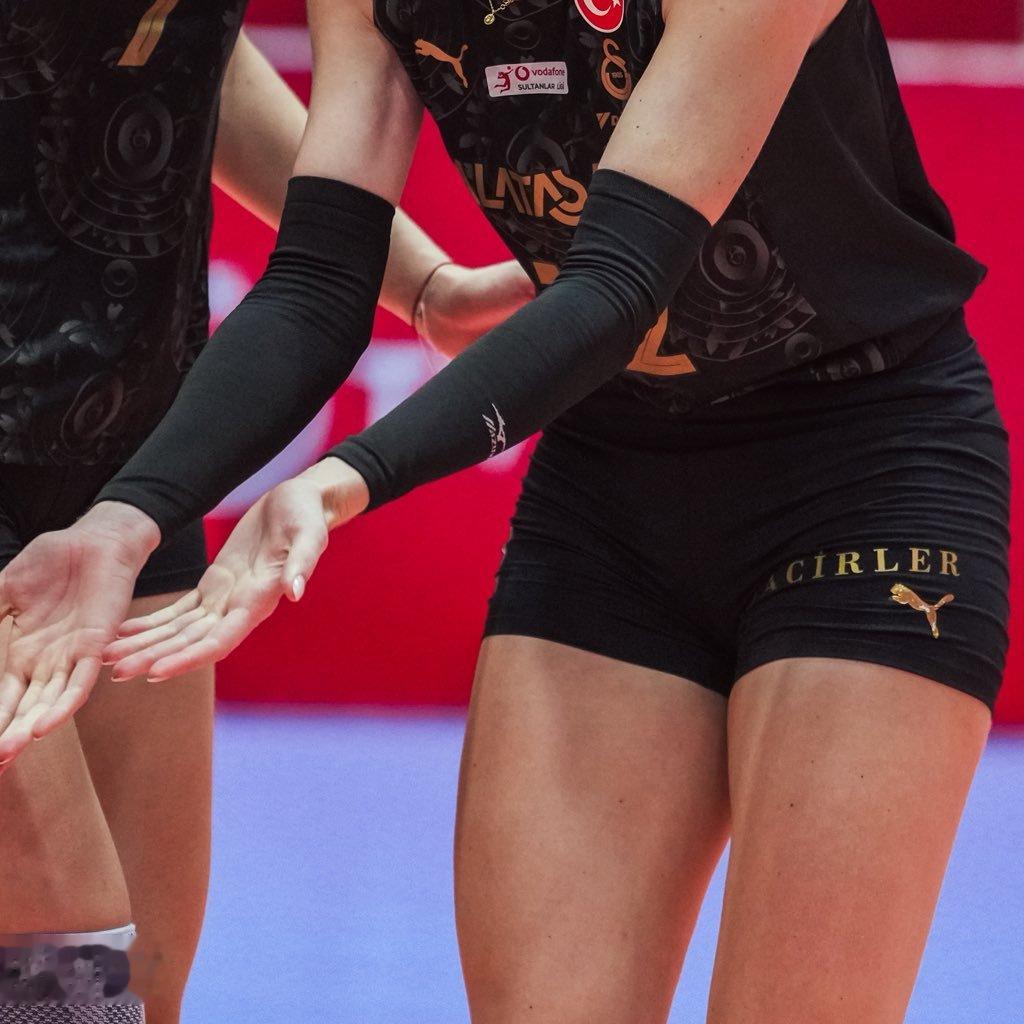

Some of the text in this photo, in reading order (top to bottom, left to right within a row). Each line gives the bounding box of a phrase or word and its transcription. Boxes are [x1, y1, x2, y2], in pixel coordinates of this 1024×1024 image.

[532, 67, 565, 76] vodafone
[517, 83, 555, 91] SULTANLAR
[764, 547, 961, 593] ACİRLER
